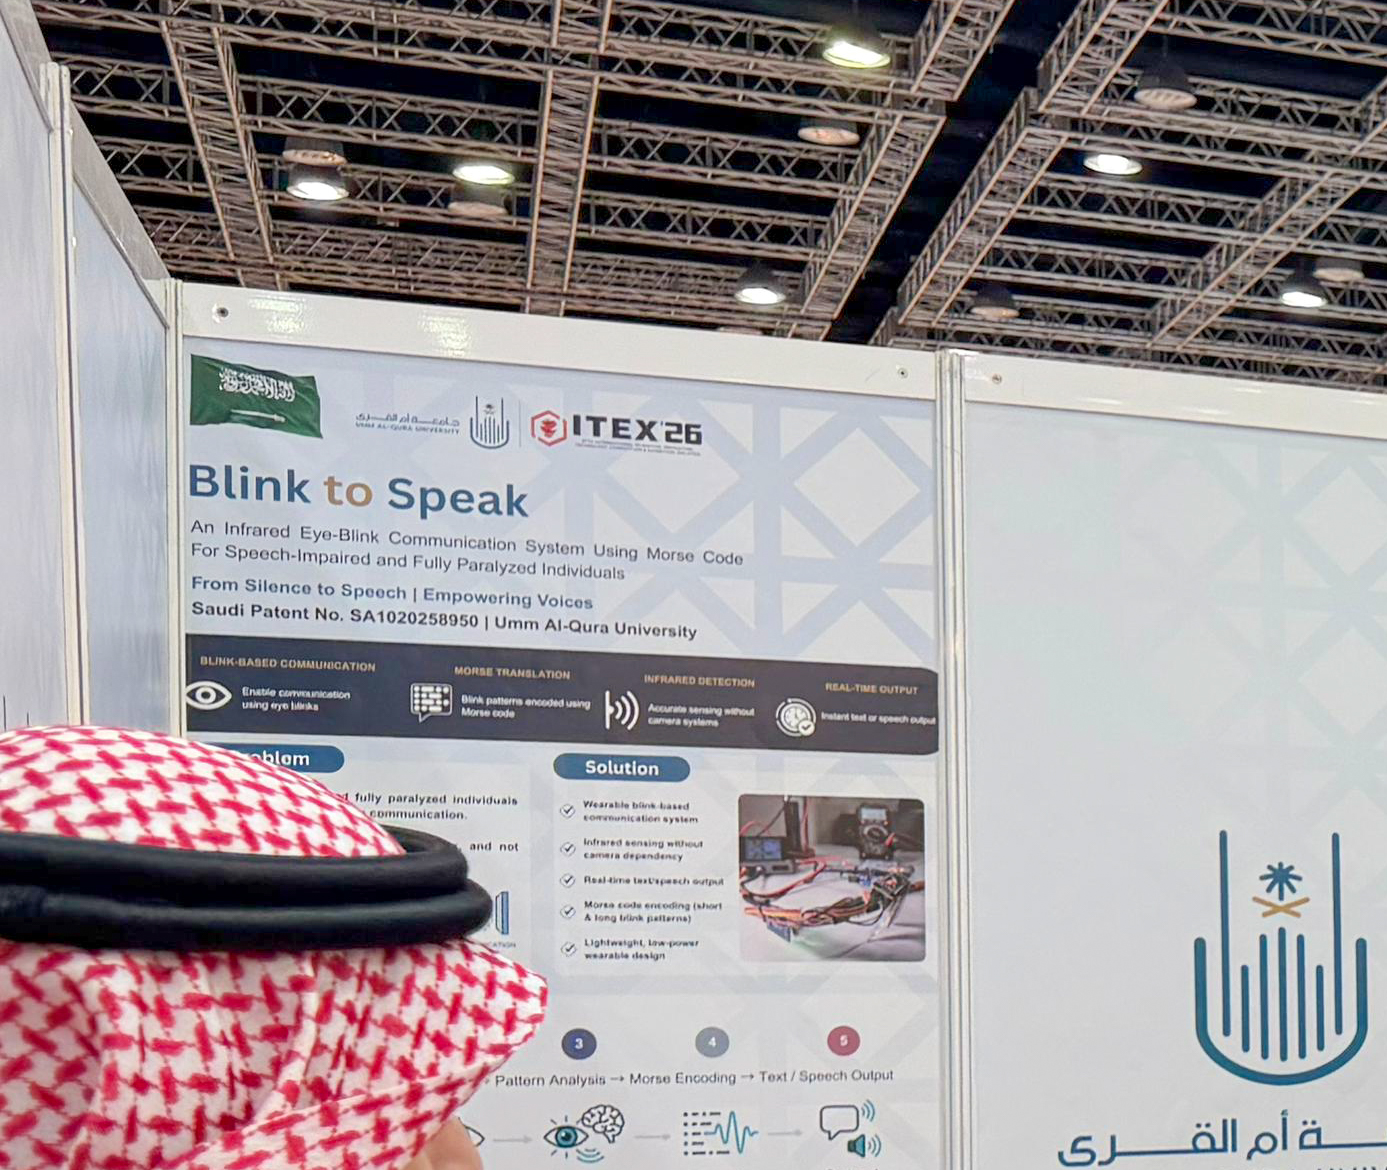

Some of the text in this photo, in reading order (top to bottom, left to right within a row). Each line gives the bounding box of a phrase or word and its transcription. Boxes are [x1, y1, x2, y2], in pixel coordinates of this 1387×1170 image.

[189, 464, 529, 520] Blink to Speak
[191, 520, 744, 566] An Infrared Eye-Blink Communication System Using Morse Code
[191, 543, 625, 580] For Speech-Impaired and Fully Paralyzed Individuals
[192, 576, 593, 610] From Silence to Speech Empowering Voices
[191, 601, 697, 641] Saudi Patent No. SA1020258950 Umm Al-Qura University
[200, 655, 376, 673] BLINK-BASED COMMUNICATION
[454, 666, 571, 680] MORSE TRANSLATION
[644, 674, 755, 688] INFRARED DETECTION
[825, 682, 918, 695] REAL-TIME OUTPUT
[585, 760, 659, 776] Solution
[355, 793, 518, 806] fully paralyzed individuals
[370, 809, 468, 820] communication.
[469, 842, 519, 852] and not
[575, 1038, 583, 1049] 3
[707, 1036, 716, 1047] 4
[839, 1035, 848, 1046] 5
[495, 1069, 893, 1088] Pattern Analysis Morse Encoding Text Speech Output
[1058, 1118, 1237, 1167] القرى
[1246, 1109, 1289, 1160] أم
